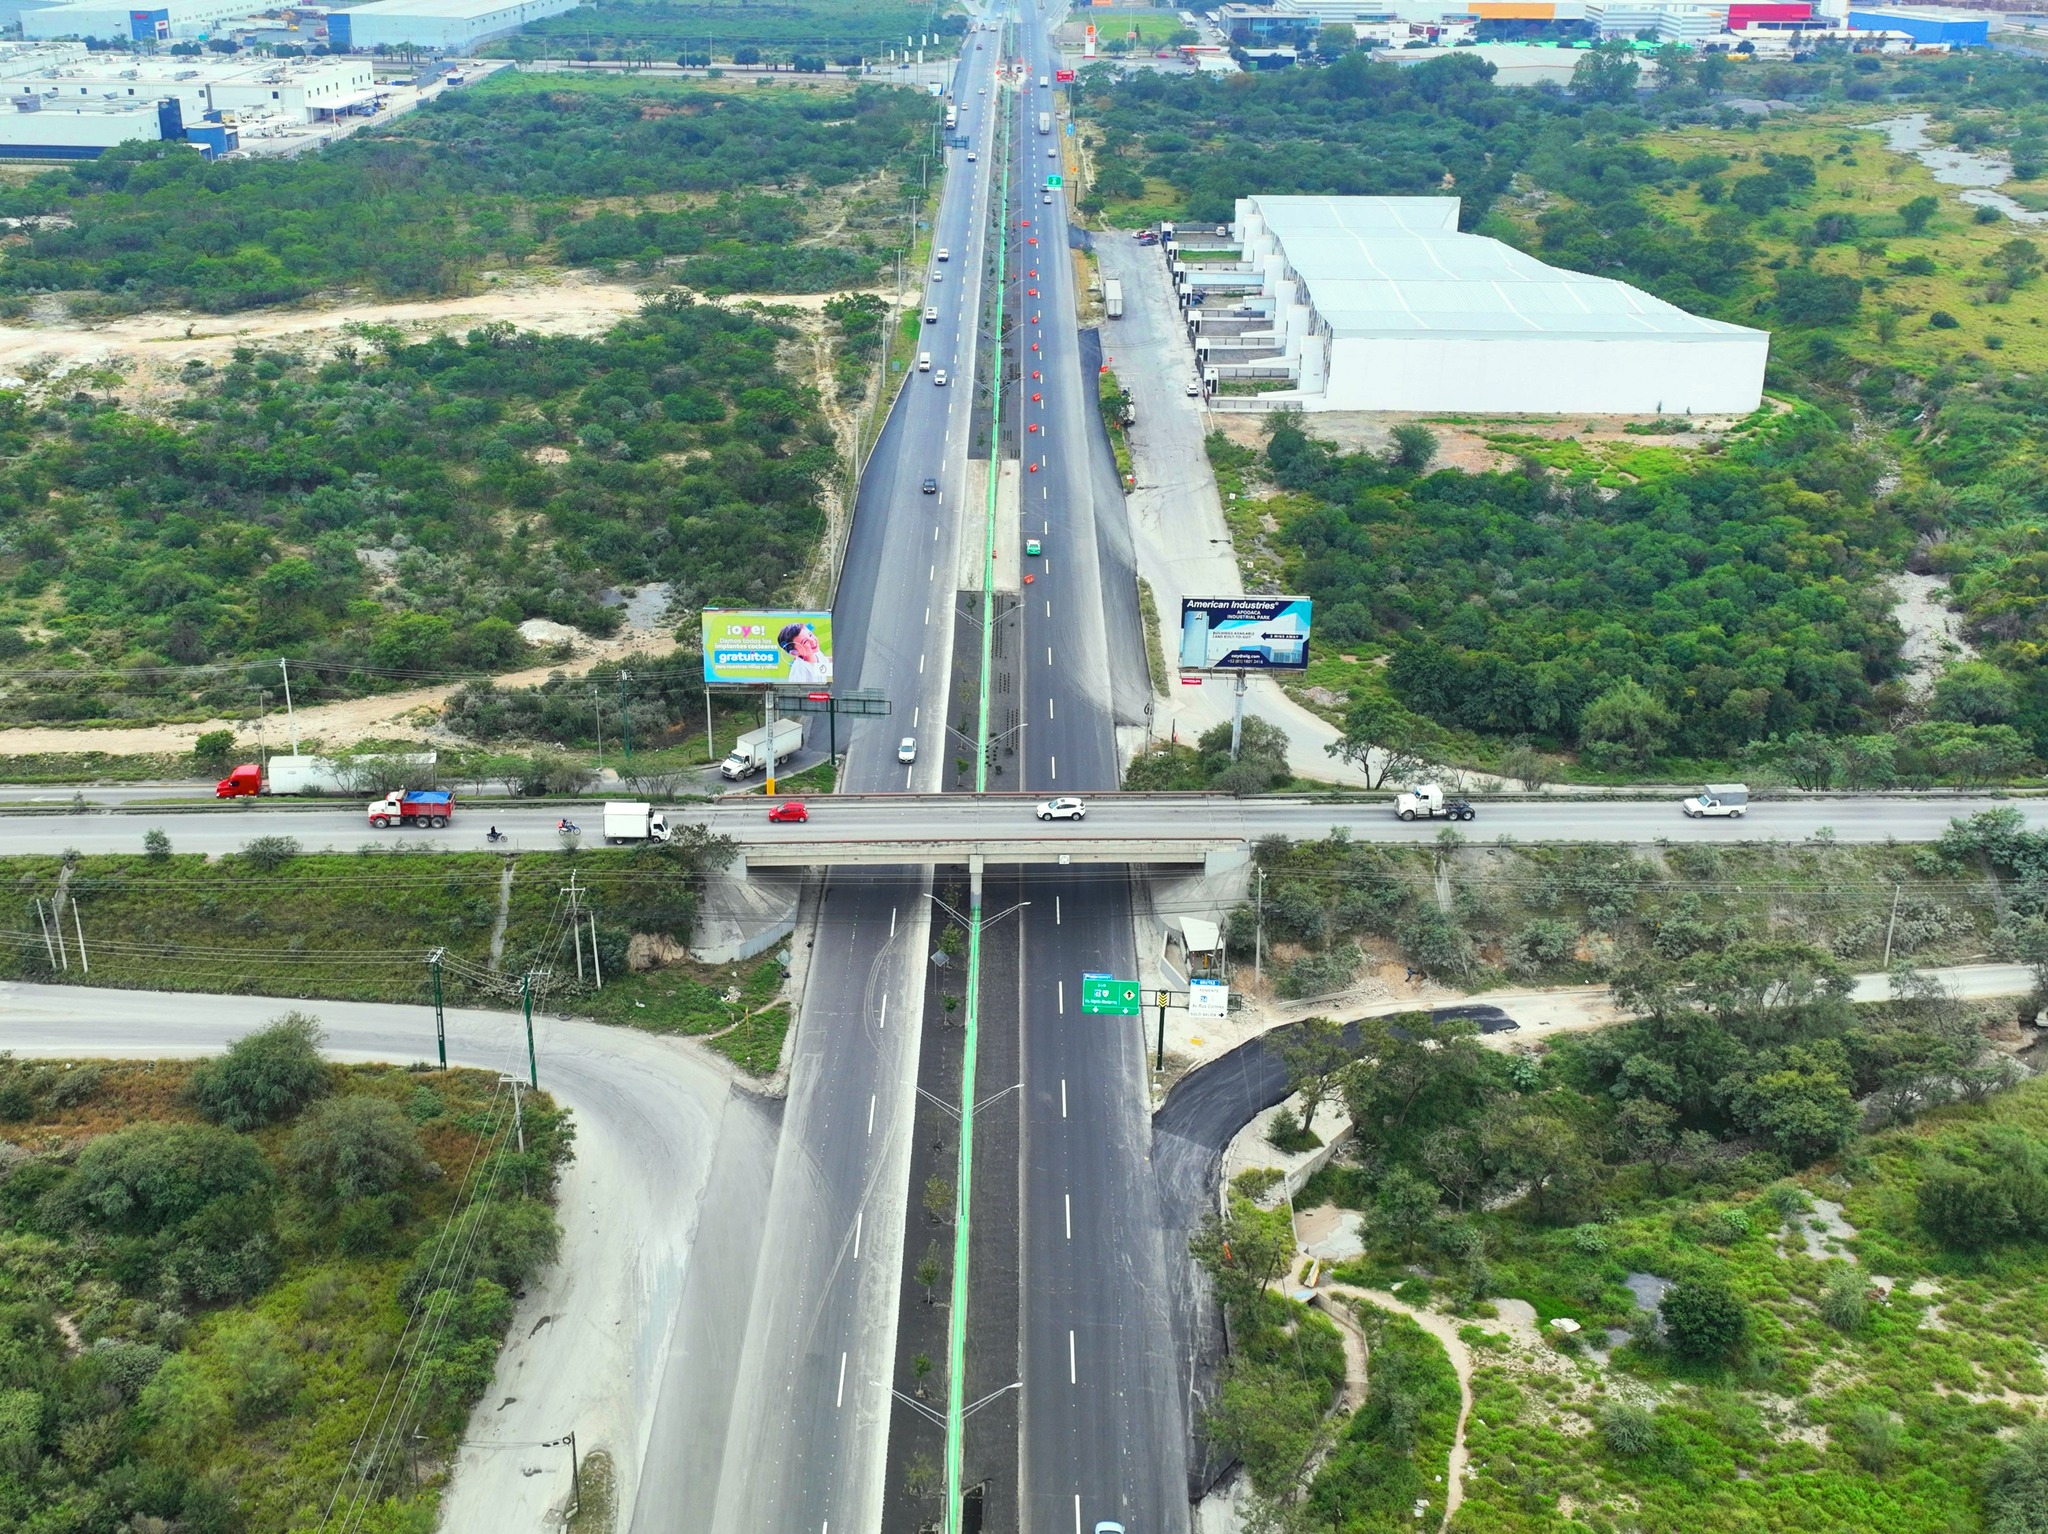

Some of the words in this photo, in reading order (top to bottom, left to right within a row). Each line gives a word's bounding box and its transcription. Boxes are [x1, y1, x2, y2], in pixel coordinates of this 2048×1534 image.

[1186, 600, 1229, 609] American
[727, 625, 765, 638] ¡oye!
[719, 650, 774, 663] gratuitos
